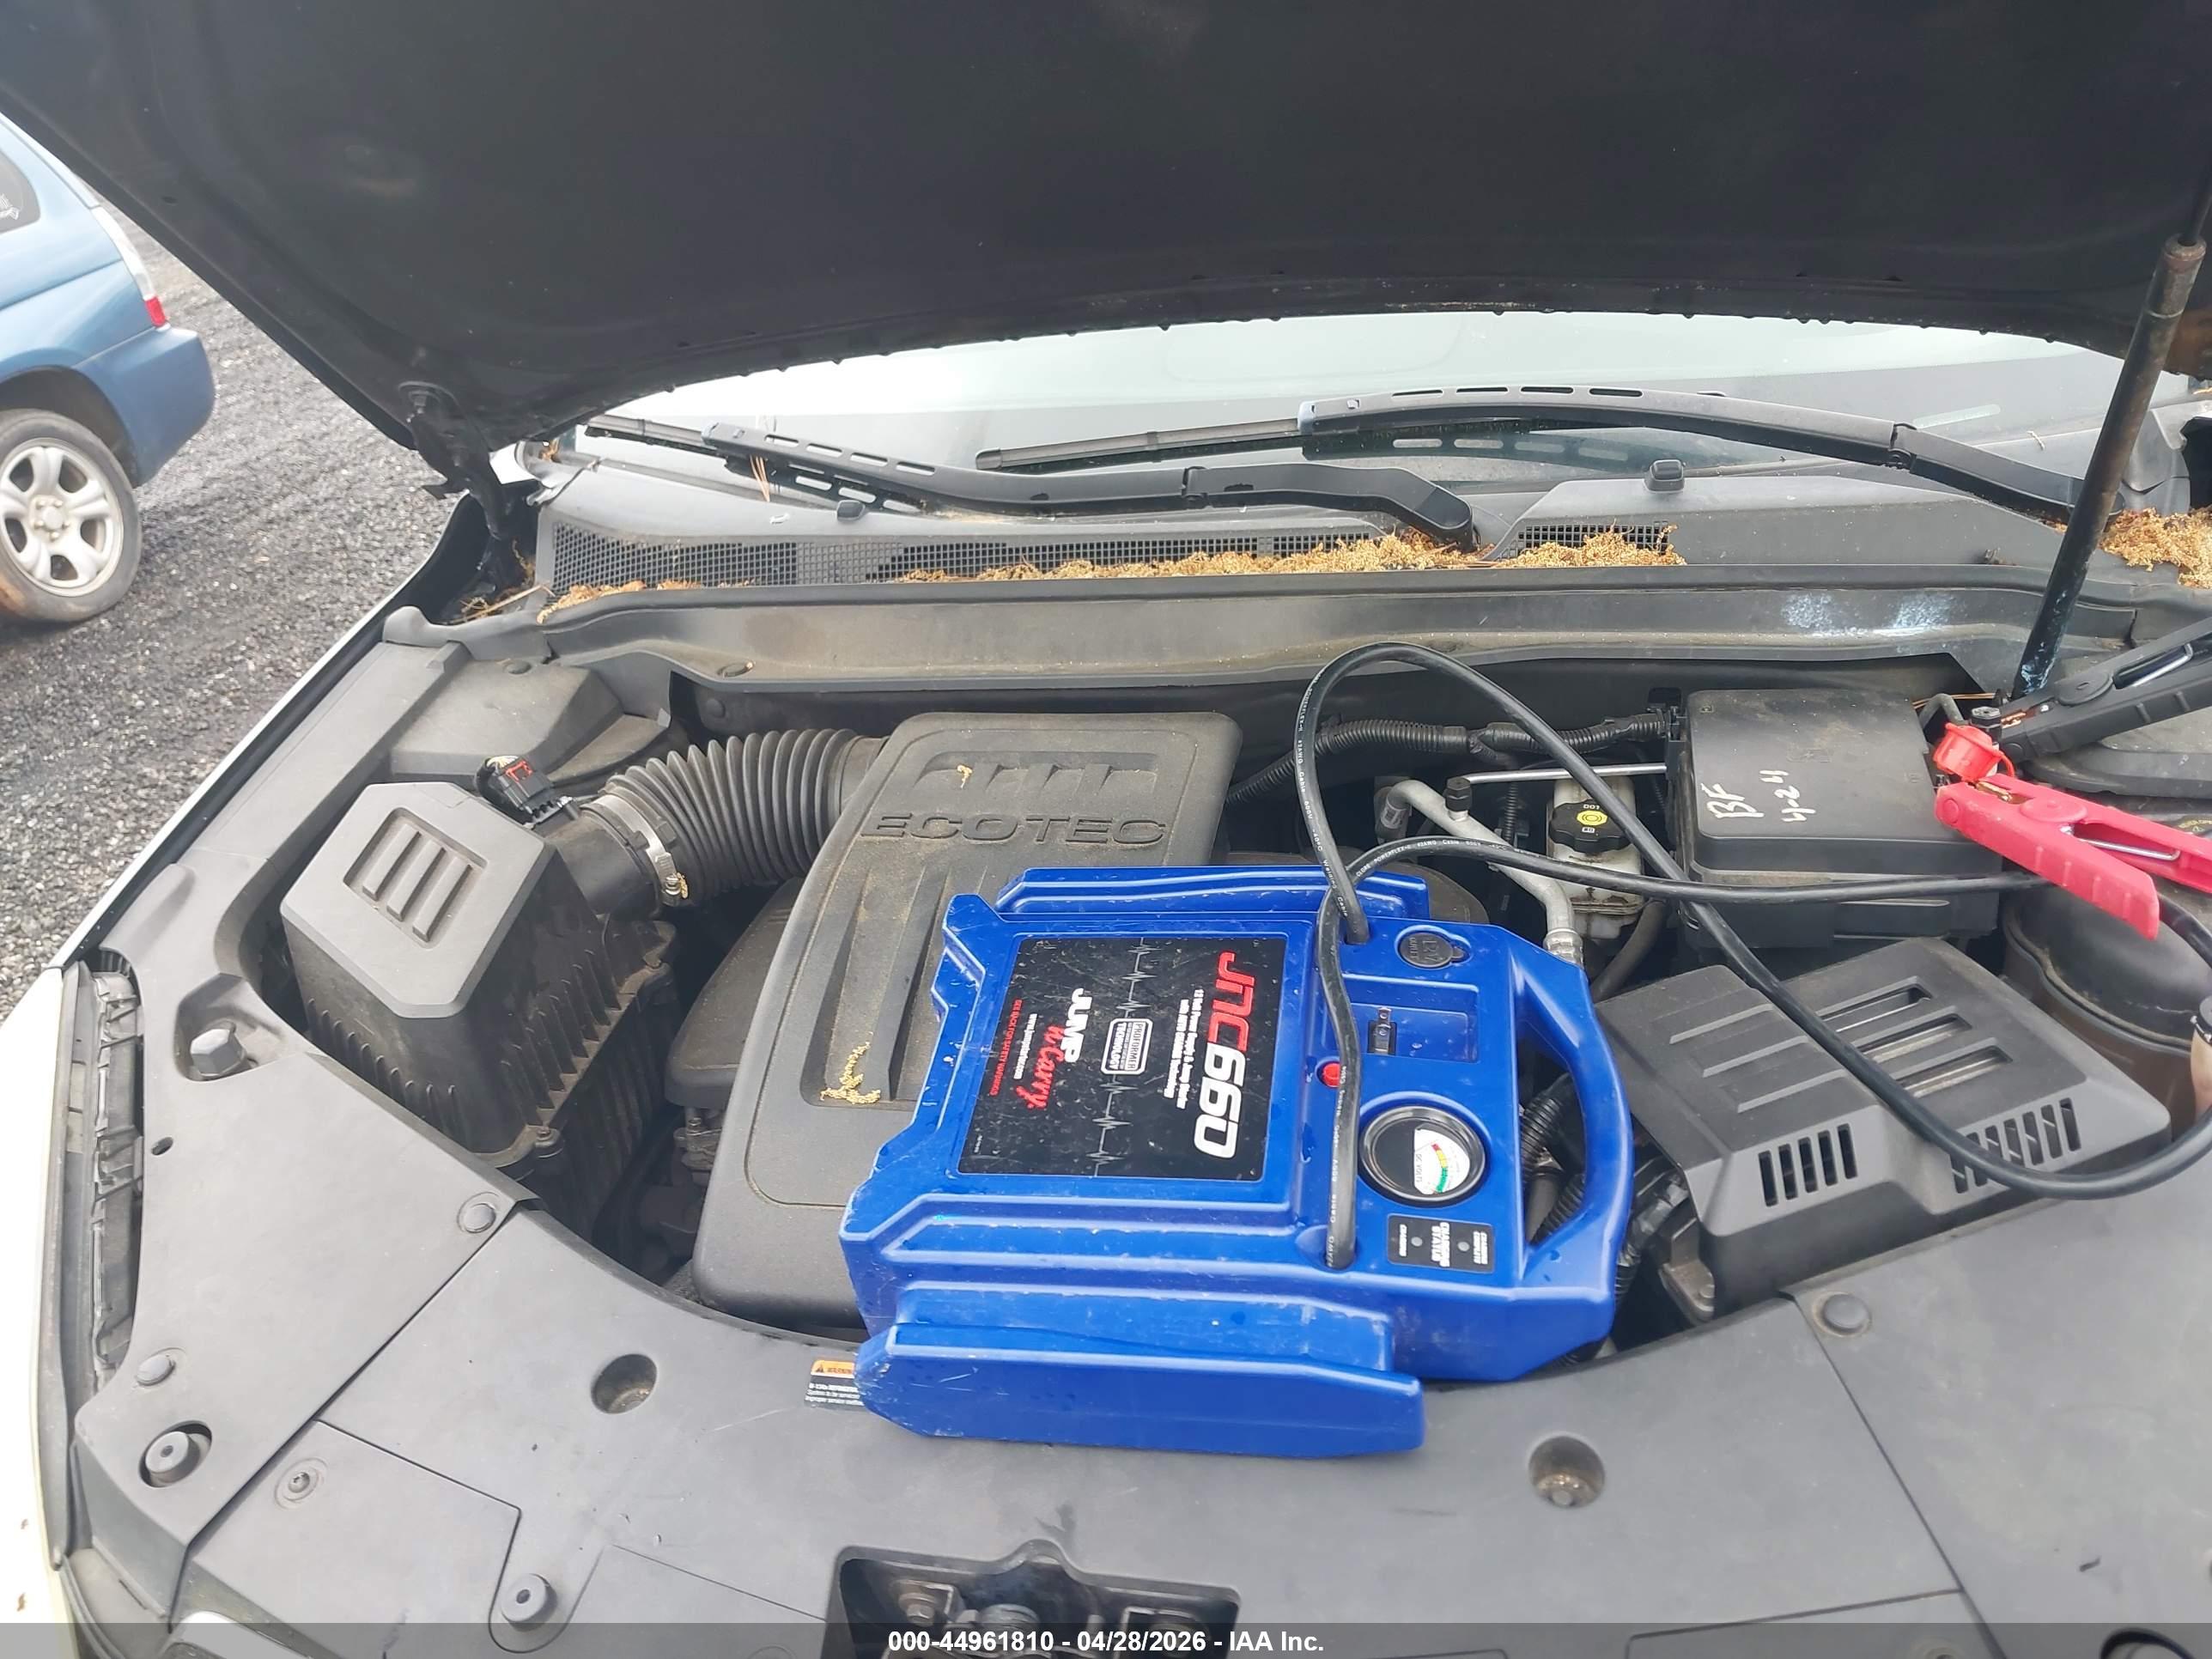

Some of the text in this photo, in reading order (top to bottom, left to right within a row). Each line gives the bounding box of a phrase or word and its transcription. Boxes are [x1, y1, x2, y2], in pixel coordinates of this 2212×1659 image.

[860, 815, 1166, 845] ECOTEC
[1060, 988, 1092, 1063] JUMP
[1109, 1022, 1127, 1070] TECHNOLOGY
[1127, 1023, 1143, 1069] PROFORMER
